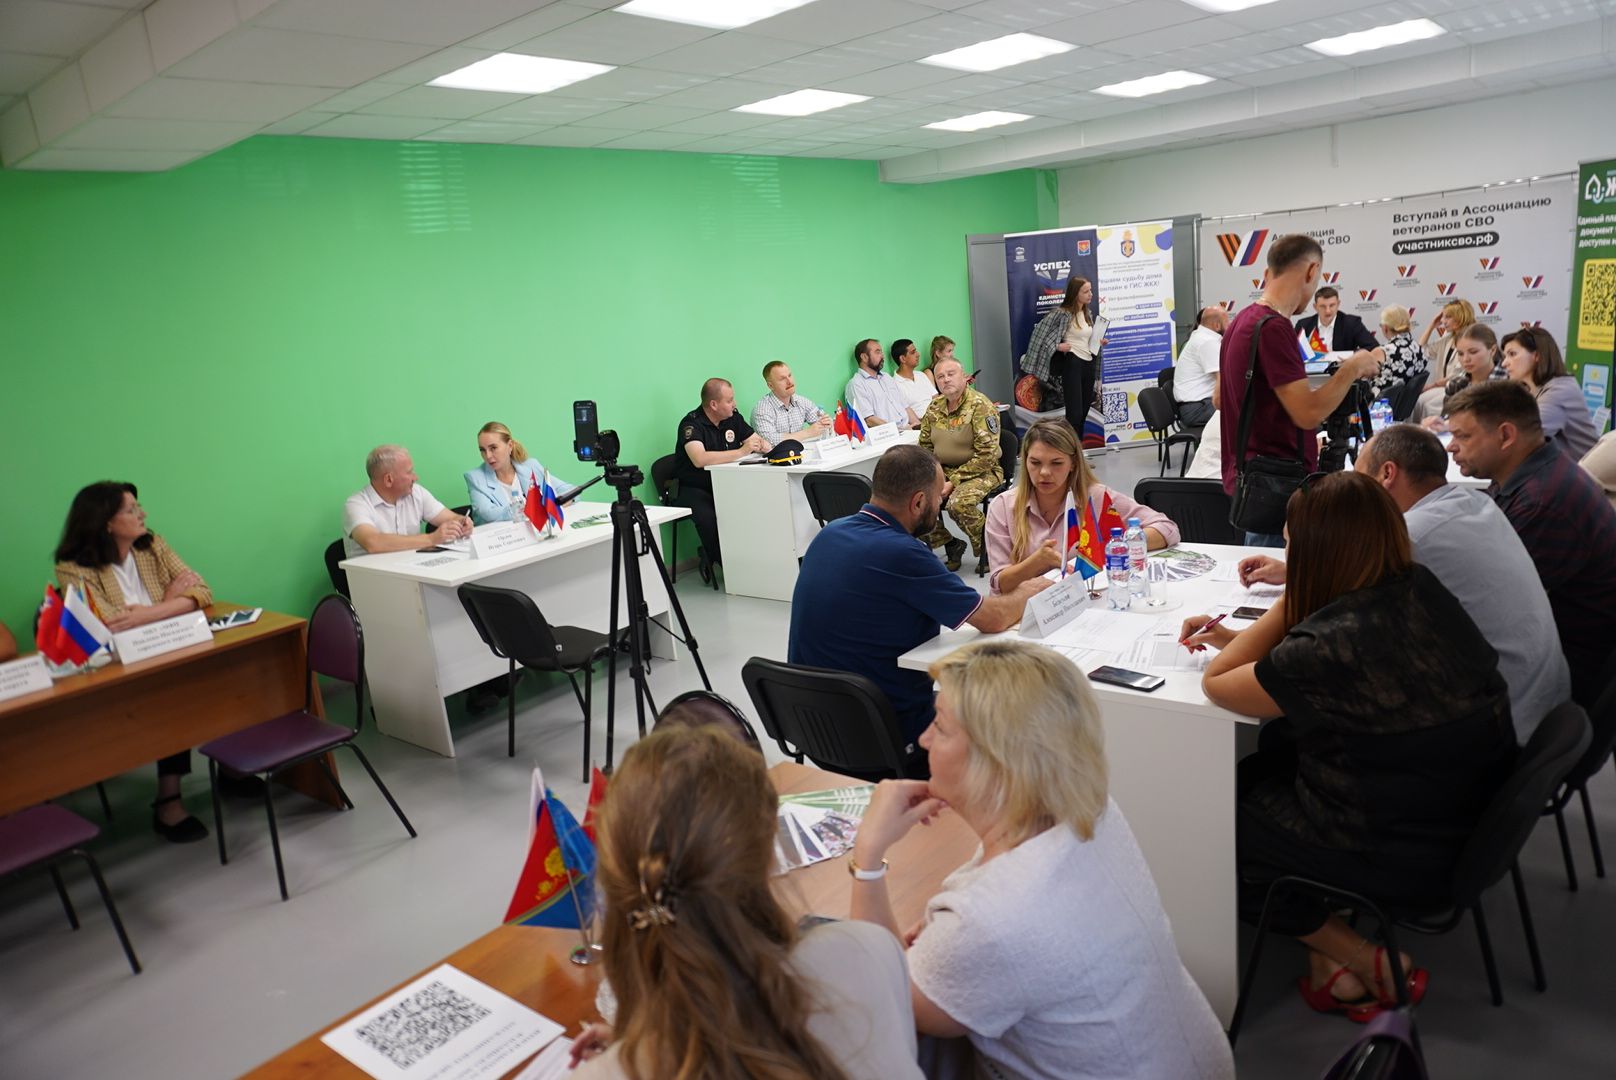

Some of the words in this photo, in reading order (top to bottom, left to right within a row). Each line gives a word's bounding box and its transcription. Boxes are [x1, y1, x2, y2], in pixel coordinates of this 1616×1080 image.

[1393, 208, 1448, 223] Вступай
[1451, 208, 1459, 217] в
[1462, 197, 1552, 216] Ассоциацию
[1392, 221, 1461, 236] ветеранов
[1465, 215, 1495, 228] СВО
[1327, 235, 1351, 246] СВО
[1397, 233, 1494, 254] участниксво.рф
[1034, 260, 1071, 272] УСПЕХ
[1038, 293, 1066, 301] ЕДИНСТВ
